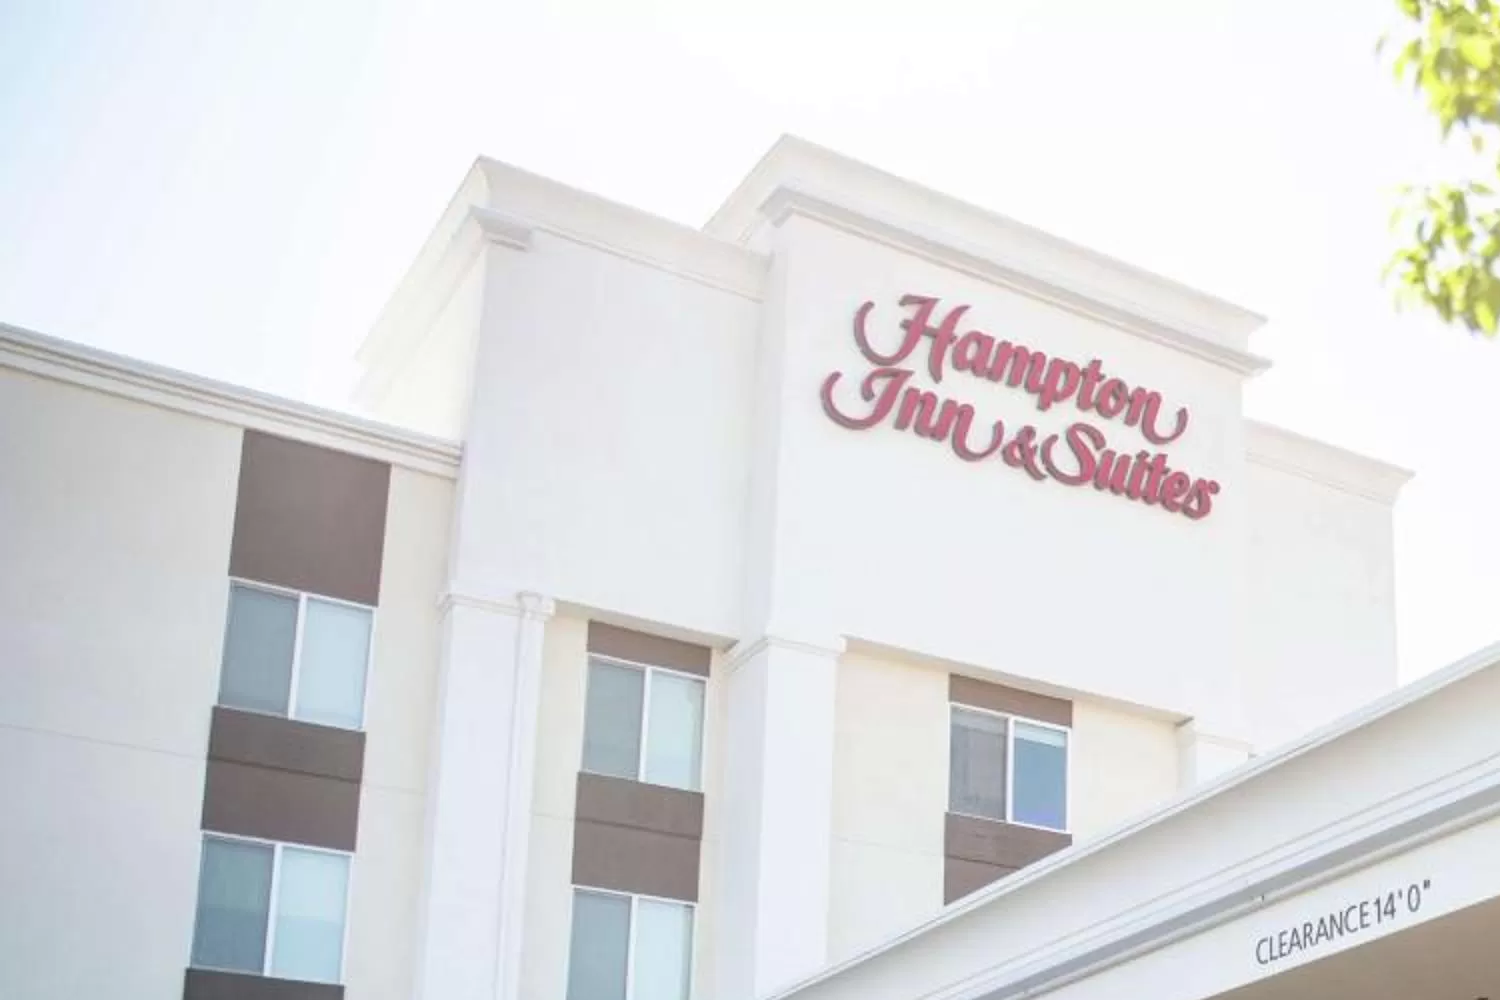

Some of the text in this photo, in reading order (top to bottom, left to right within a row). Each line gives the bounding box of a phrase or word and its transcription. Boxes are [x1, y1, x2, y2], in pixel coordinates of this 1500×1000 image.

[820, 368, 1220, 520] Inn & Suites
[853, 295, 1188, 445] Hampton
[1255, 901, 1371, 965] CLEARANCE
